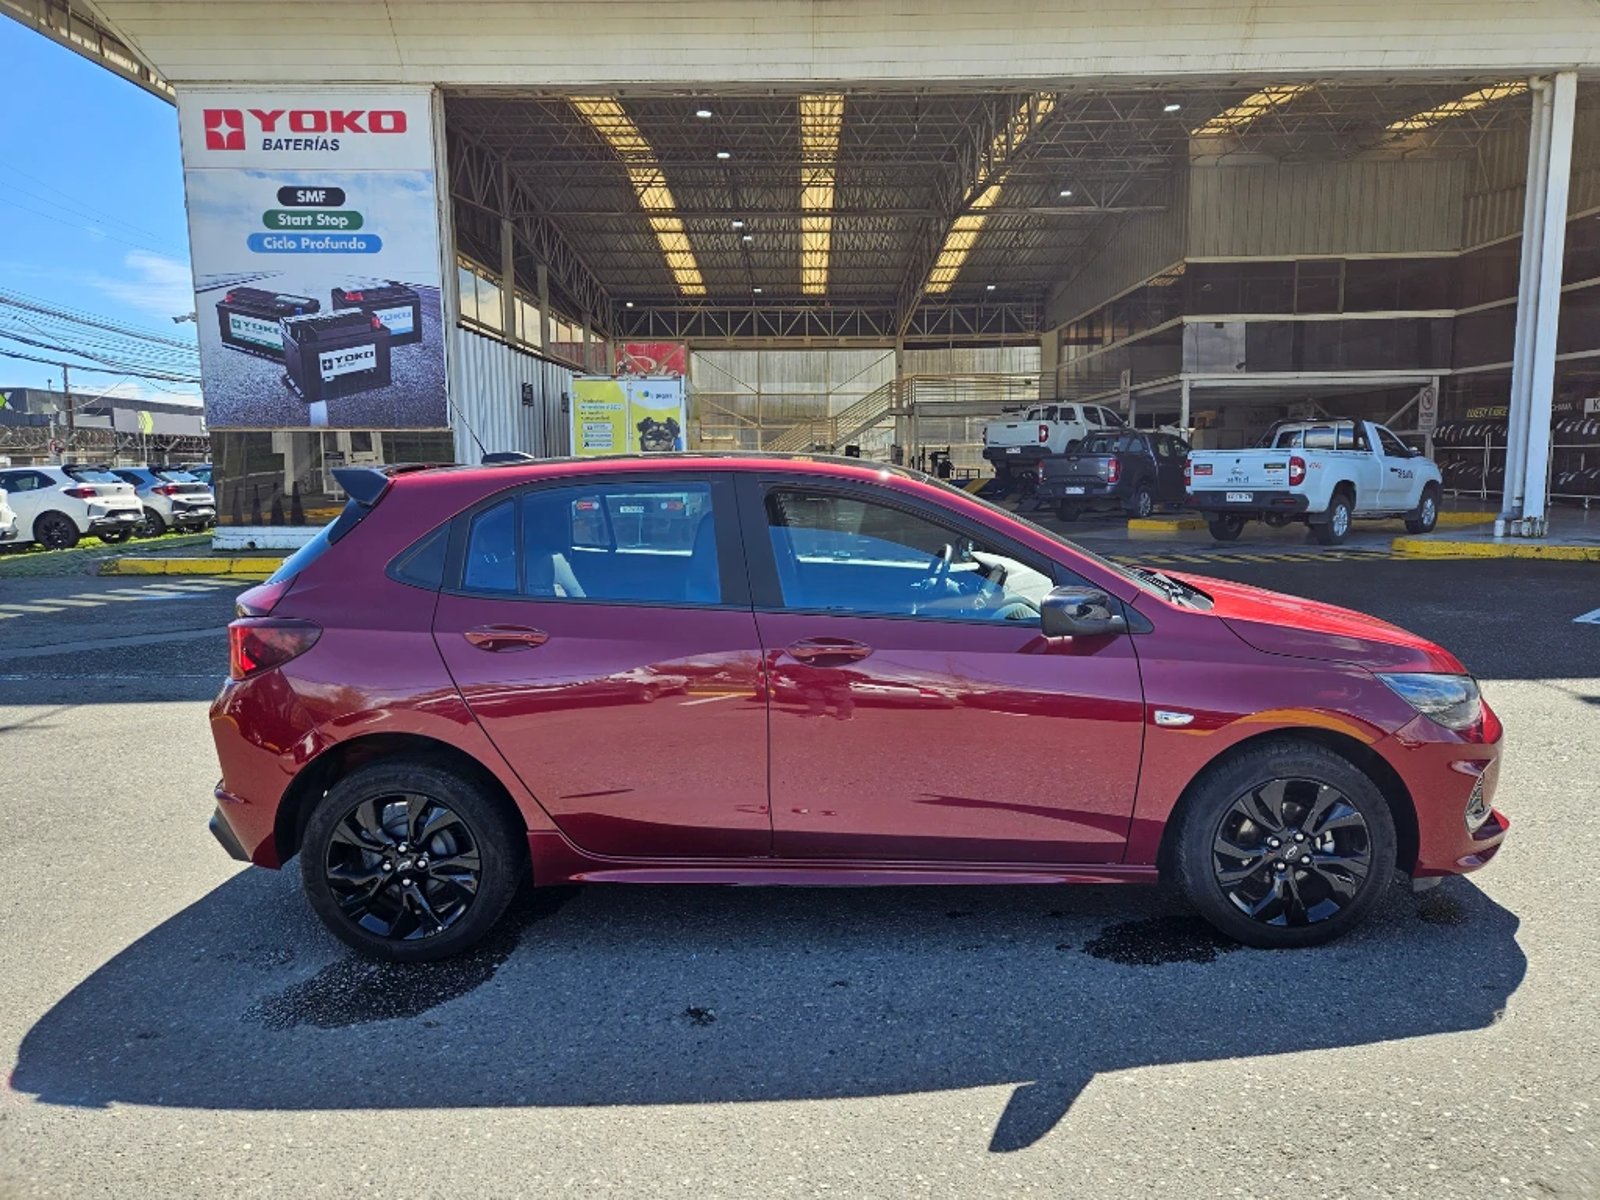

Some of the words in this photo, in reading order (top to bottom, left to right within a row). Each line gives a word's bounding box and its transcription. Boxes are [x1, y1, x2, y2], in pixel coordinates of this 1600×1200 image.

[247, 109, 407, 133] YOKO
[262, 136, 340, 151] BATERÍAS
[296, 190, 326, 203] SMF
[278, 213, 313, 226] Start
[317, 213, 349, 229] Stop
[263, 237, 297, 250] Ciclo
[301, 237, 366, 251] Profundo
[334, 350, 374, 363] YOKO
